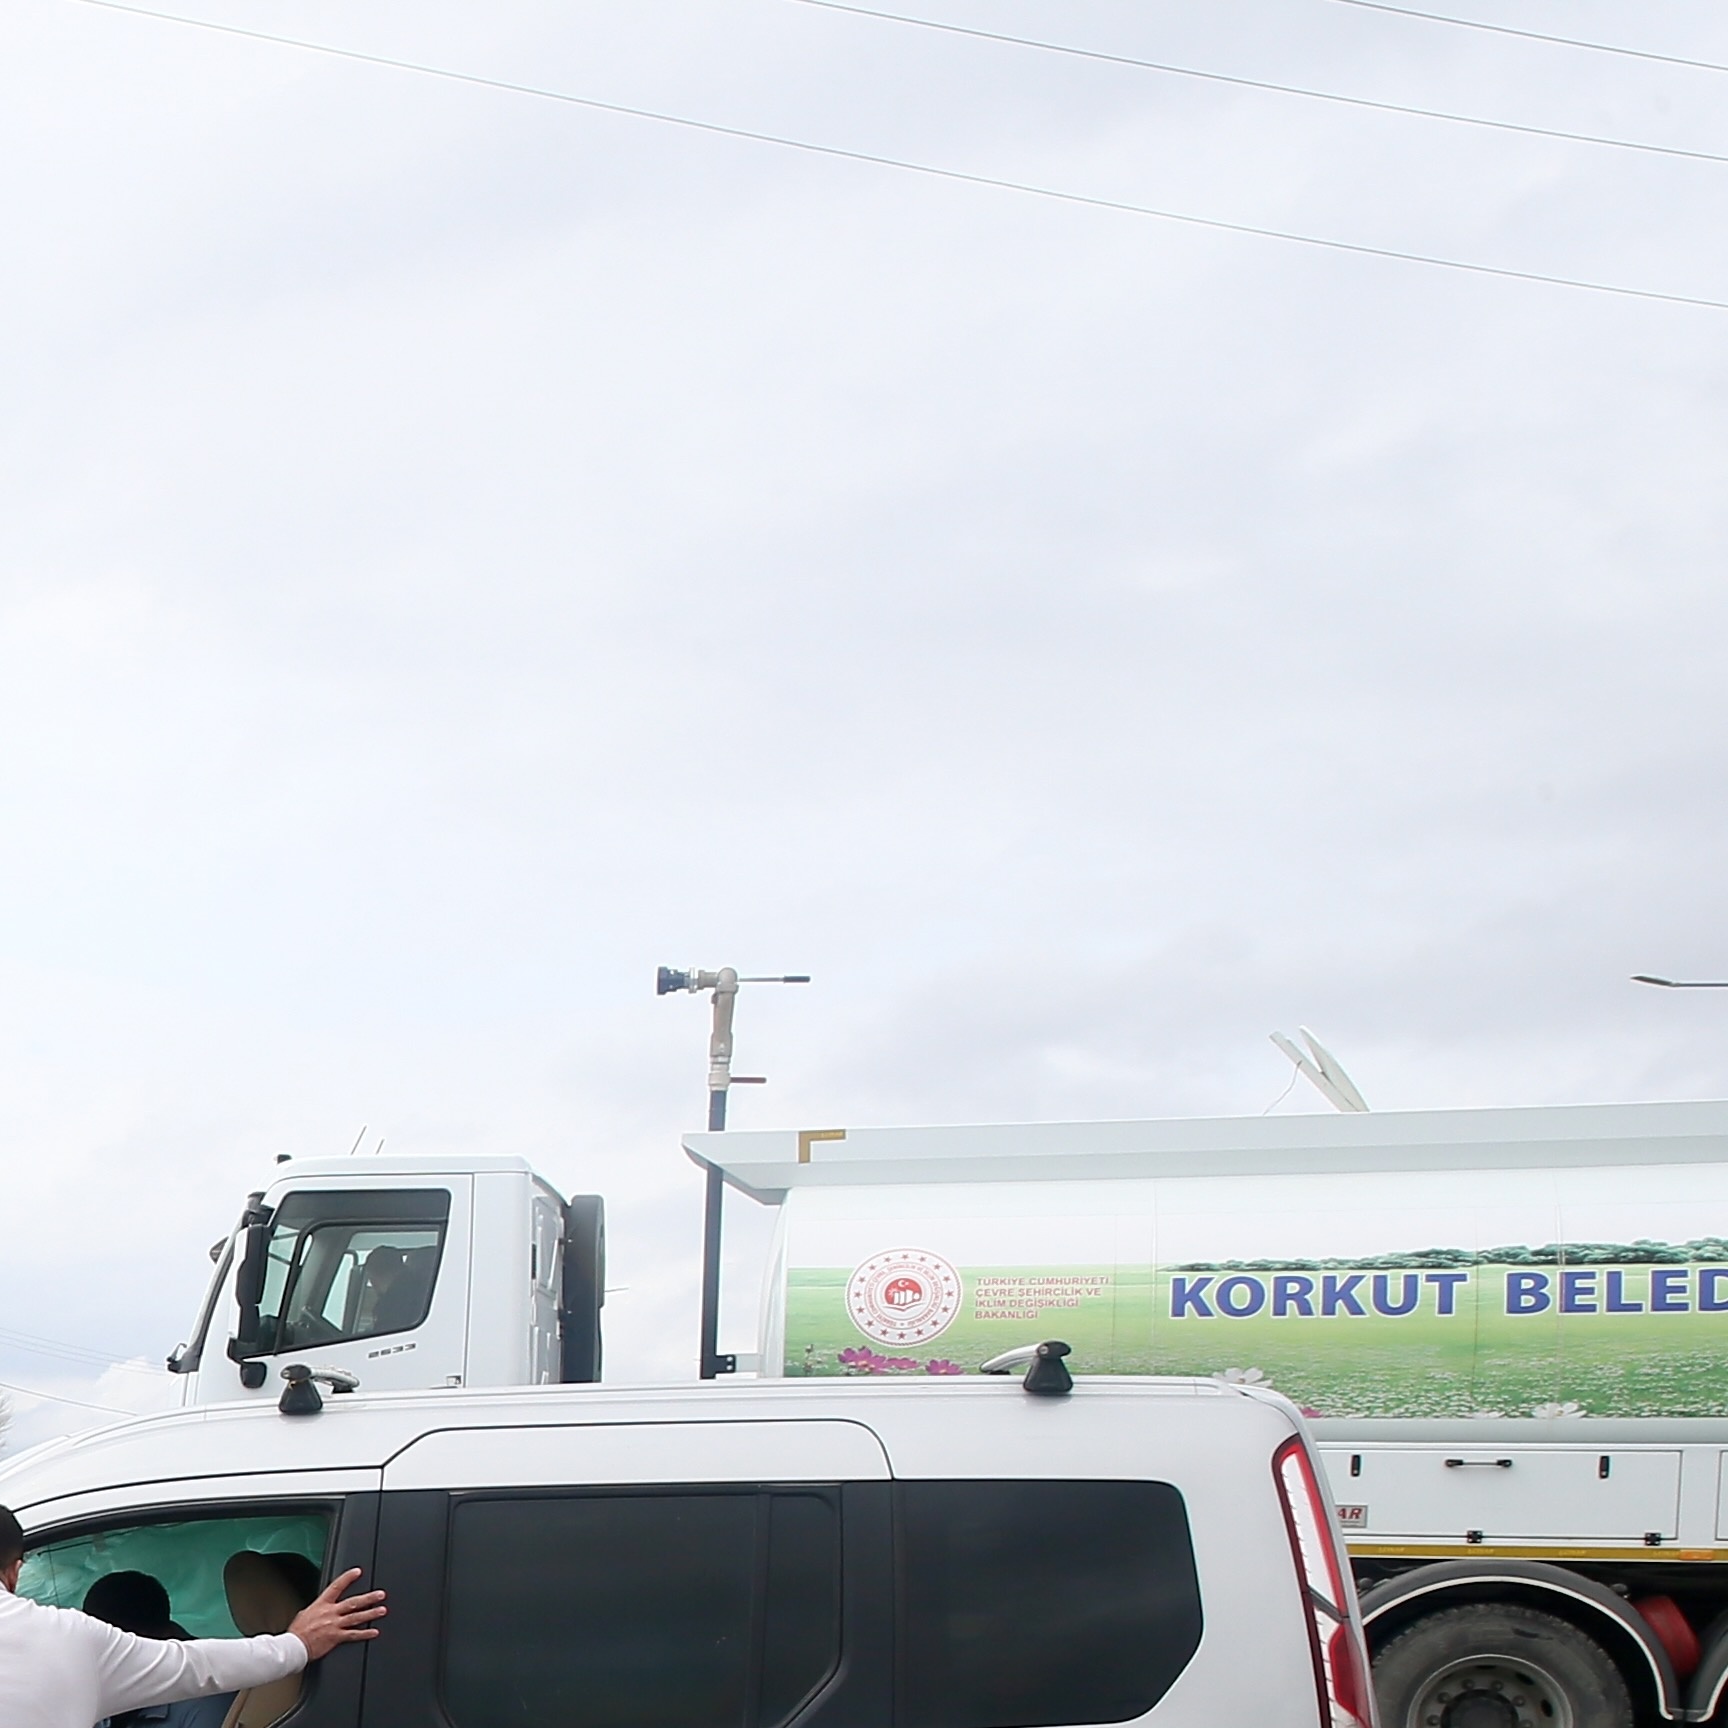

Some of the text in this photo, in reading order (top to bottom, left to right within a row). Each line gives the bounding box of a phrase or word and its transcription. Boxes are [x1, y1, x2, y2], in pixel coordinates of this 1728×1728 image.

[975, 1287, 1014, 1298] ÇEVRE
[1086, 1287, 1102, 1296] VE
[1169, 1268, 1728, 1318] KORKUT BELED
[975, 1309, 1038, 1320] BAKANLIĞI
